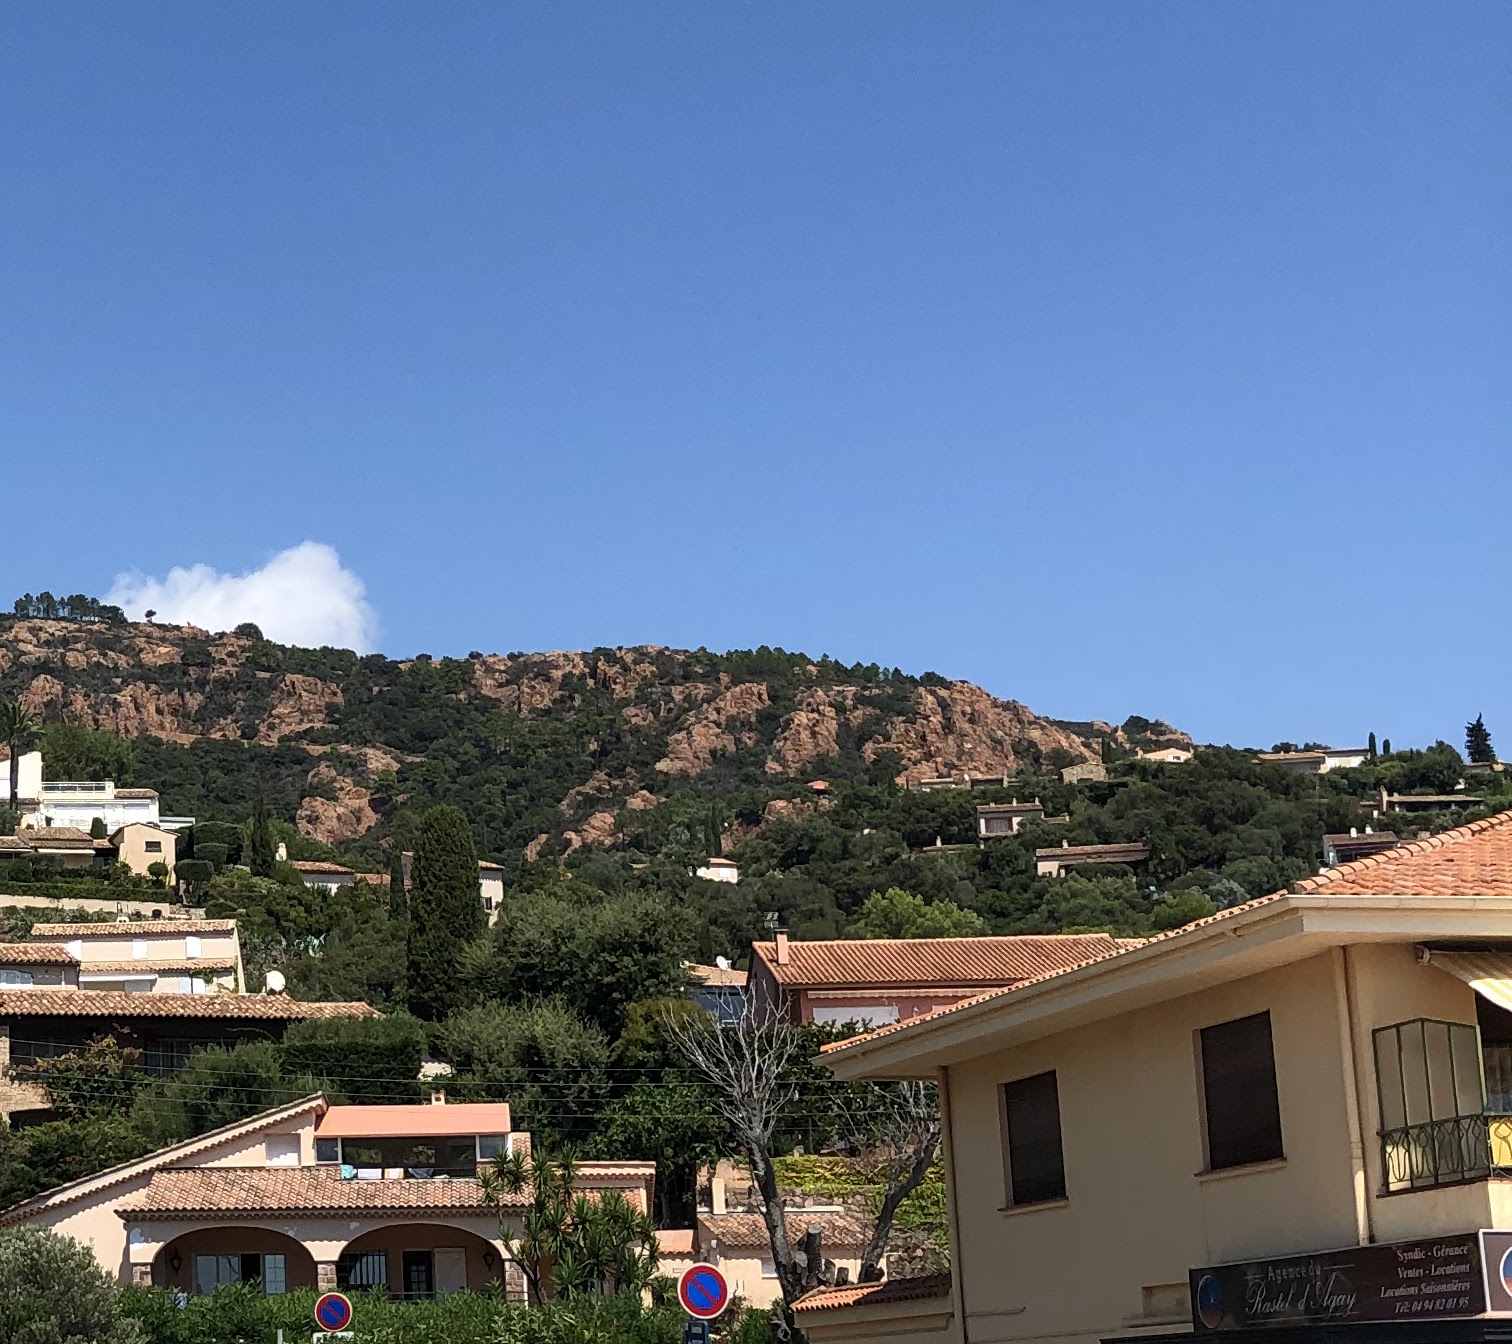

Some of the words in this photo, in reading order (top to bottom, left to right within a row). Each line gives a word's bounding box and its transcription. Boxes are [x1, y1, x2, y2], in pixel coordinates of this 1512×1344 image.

[1396, 1247, 1426, 1263] Syndic
[1433, 1244, 1468, 1258] Gérance
[1268, 1265, 1306, 1284] Agence
[1308, 1259, 1321, 1276] du
[1397, 1266, 1424, 1278] Ventes
[1431, 1262, 1470, 1276] Locations
[1380, 1284, 1418, 1298] Locations
[1419, 1279, 1471, 1295] Saisonnières
[1411, 1300, 1422, 1312] 04
[1423, 1299, 1434, 1311] 94
[1434, 1298, 1445, 1310] 82
[1447, 1297, 1456, 1309] 01
[1458, 1296, 1469, 1308] 95
